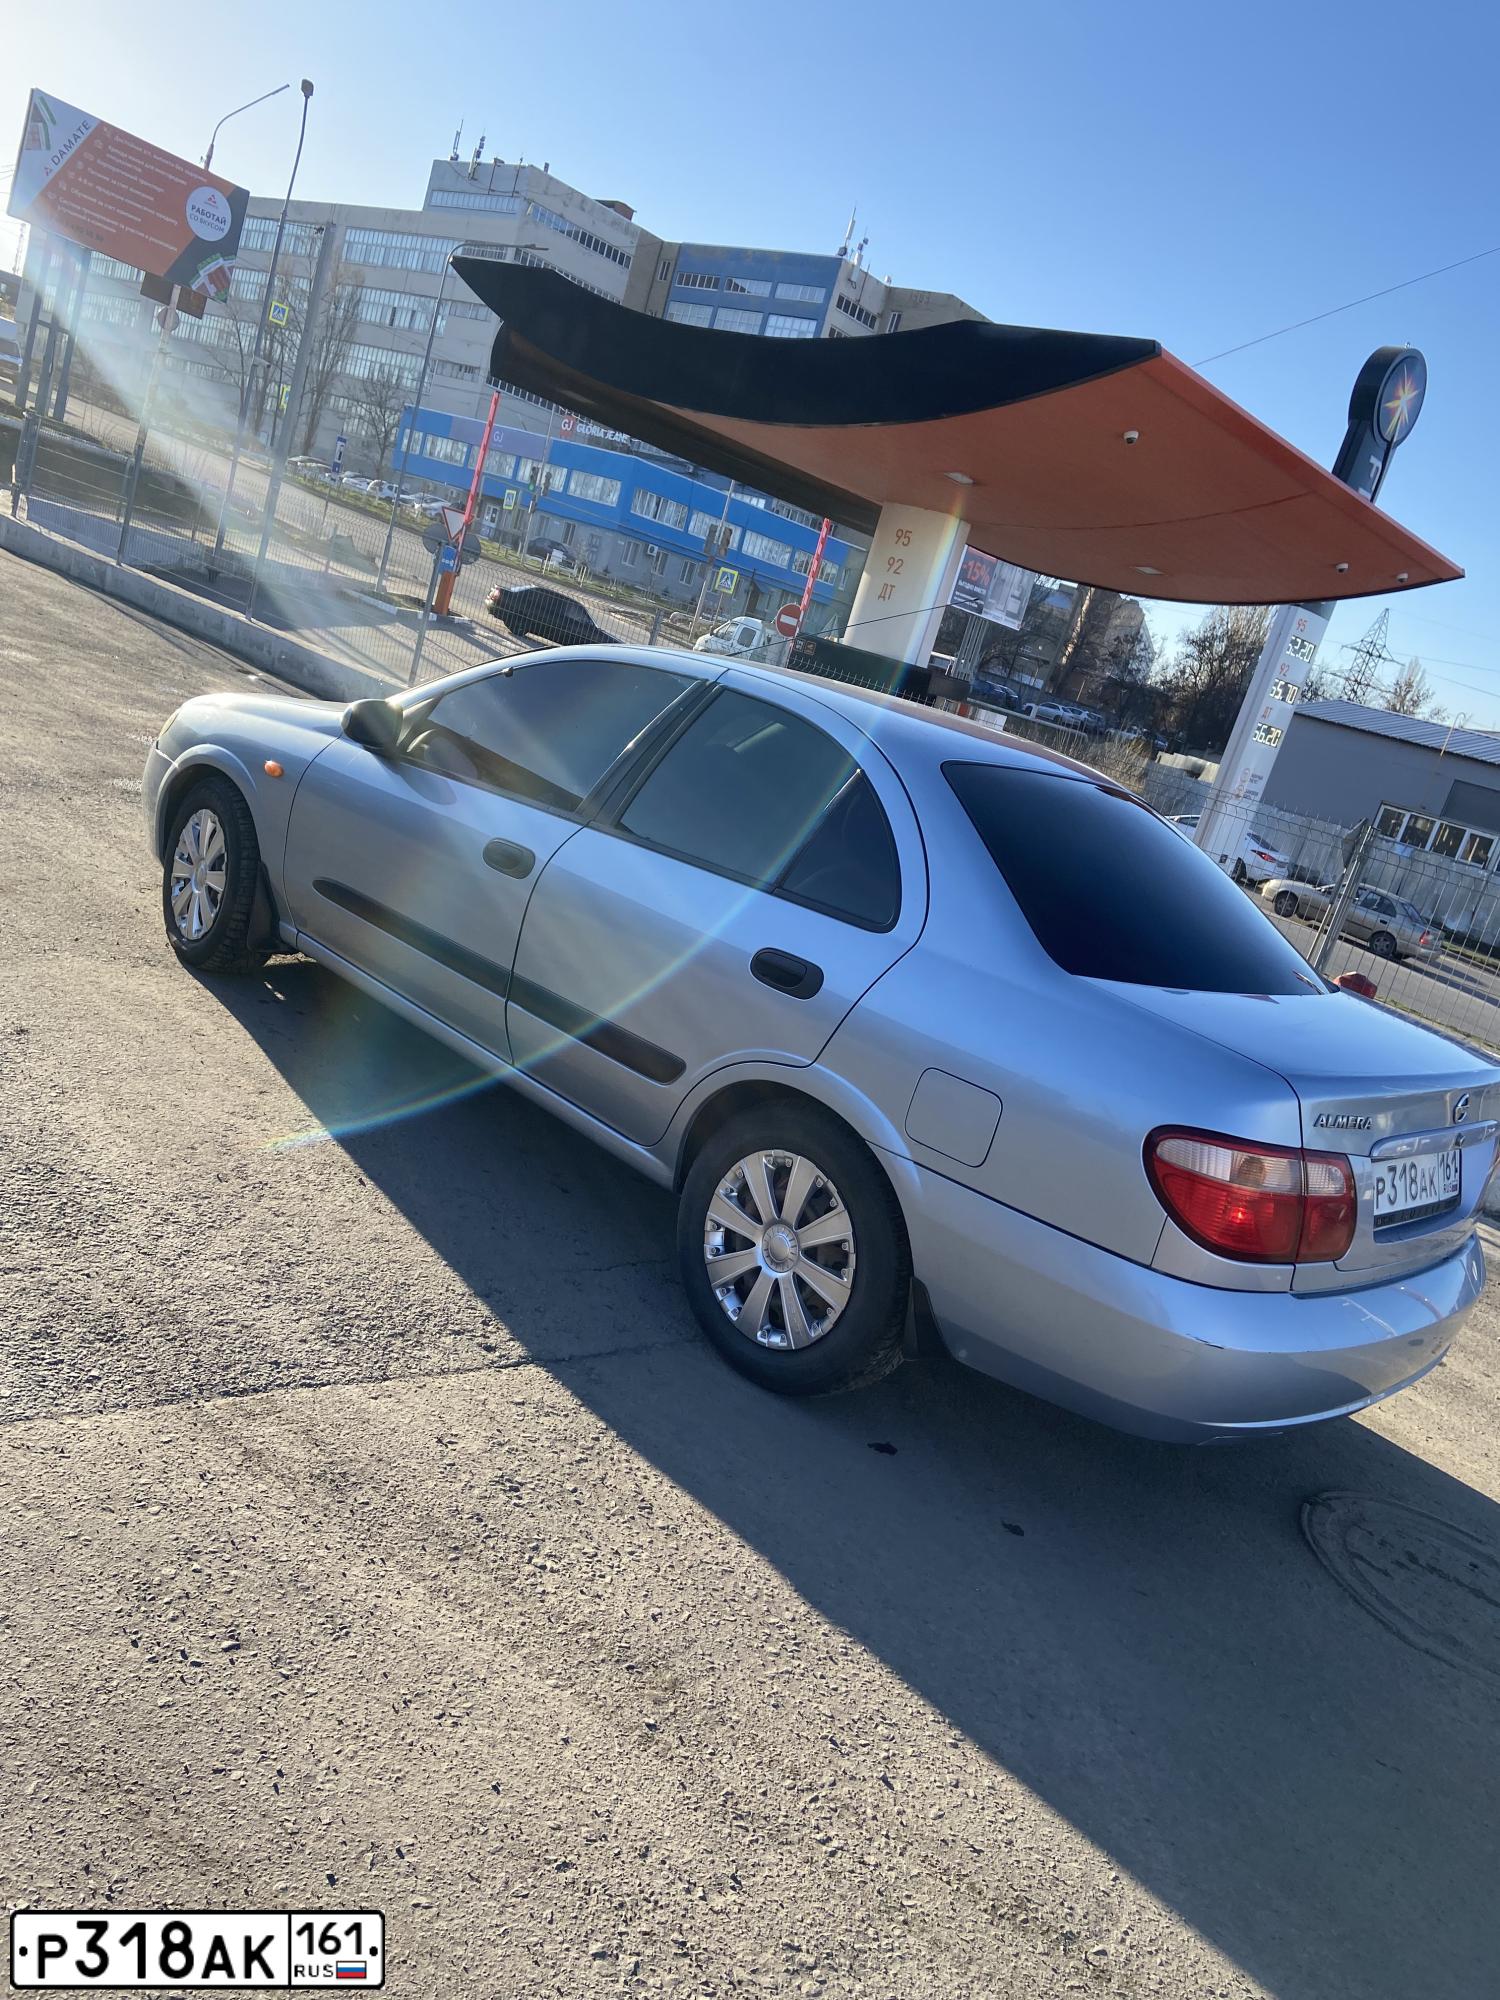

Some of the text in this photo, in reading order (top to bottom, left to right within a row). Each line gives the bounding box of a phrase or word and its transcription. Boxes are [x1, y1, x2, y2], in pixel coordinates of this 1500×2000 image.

[51, 119, 91, 165] DAMATE
[191, 204, 227, 226] РАБОТАЙ
[561, 418, 573, 431] GJ
[576, 423, 604, 438] GLORIA
[895, 528, 913, 547] 95
[886, 557, 904, 575] 92
[877, 584, 895, 601] ДТ
[1296, 618, 1308, 632] 95
[1279, 663, 1290, 677] 92
[1313, 1113, 1374, 1130] ALMERA
[1440, 1151, 1459, 1183] 161
